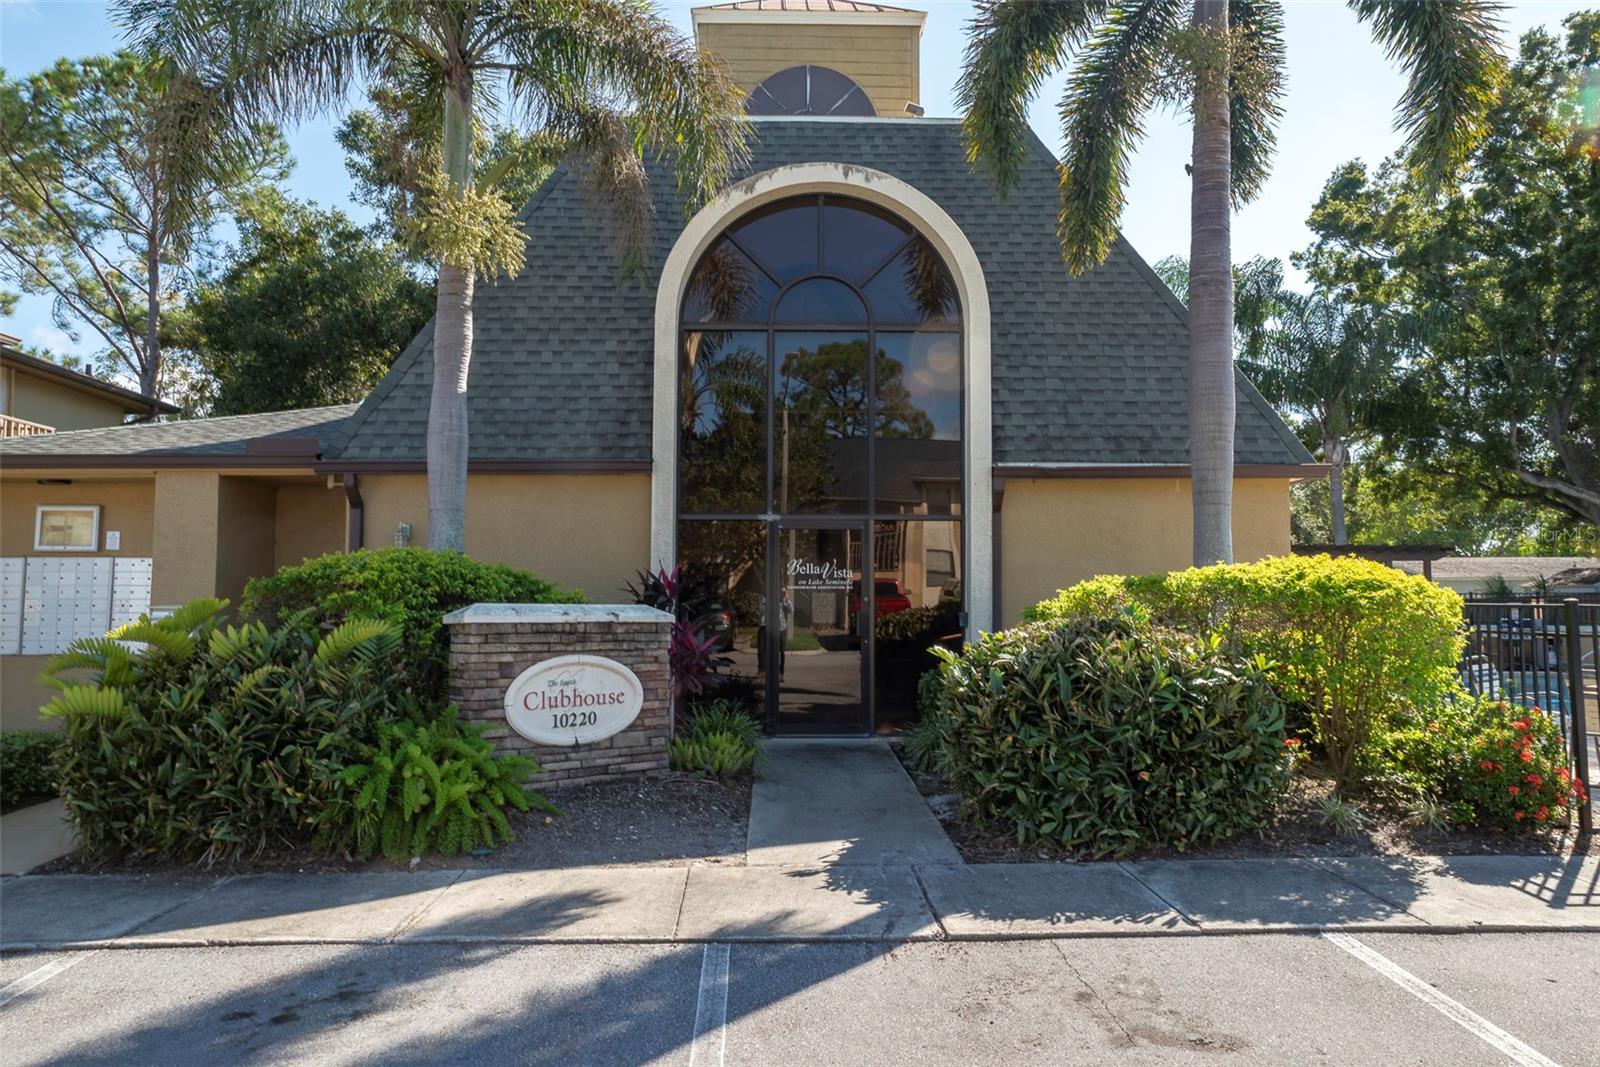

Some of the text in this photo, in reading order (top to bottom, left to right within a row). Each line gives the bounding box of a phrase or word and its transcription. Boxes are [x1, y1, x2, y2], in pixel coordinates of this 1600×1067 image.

[787, 558, 853, 579] Bella Vista
[523, 688, 625, 711] Clubhouse
[552, 711, 597, 729] 10220
